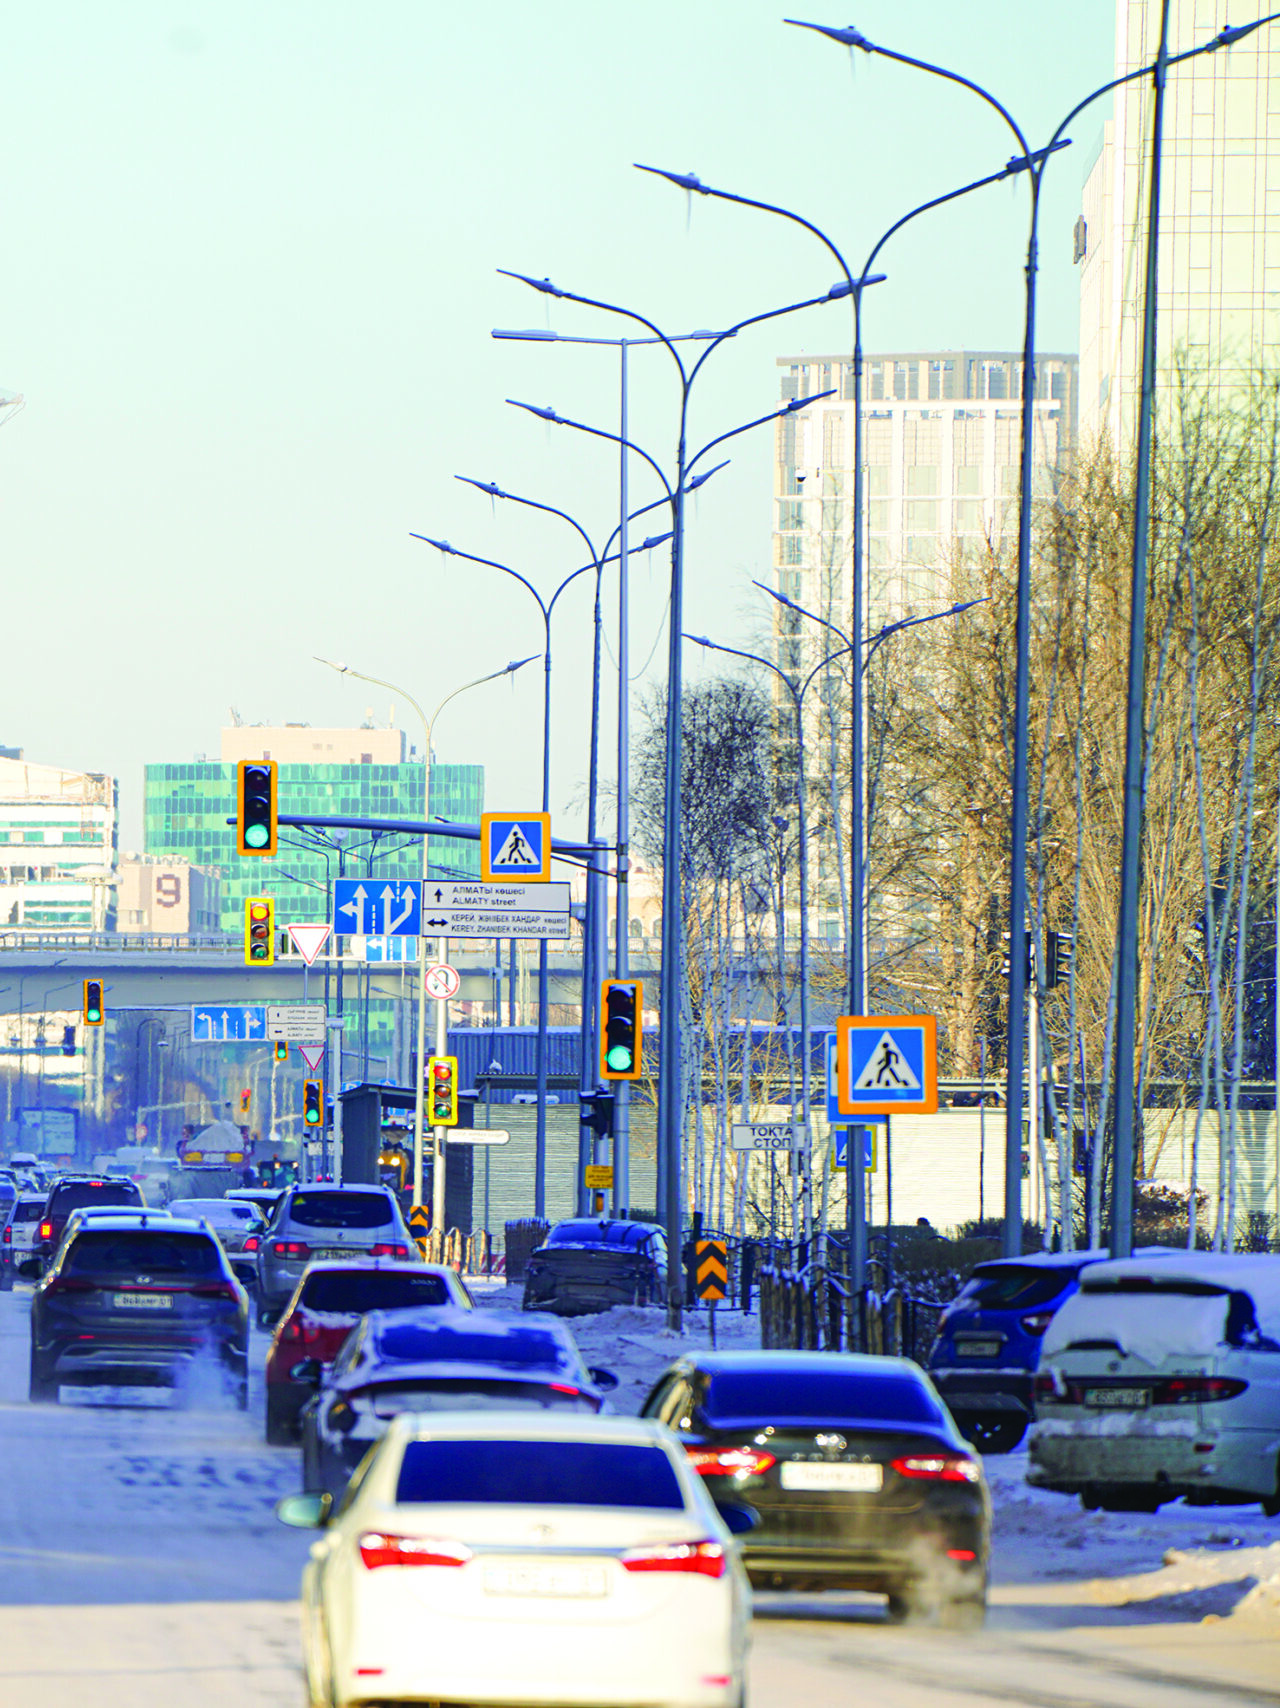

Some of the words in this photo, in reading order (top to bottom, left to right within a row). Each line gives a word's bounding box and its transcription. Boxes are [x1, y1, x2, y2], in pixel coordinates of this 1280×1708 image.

[156, 873, 181, 908] 9
[452, 886, 493, 895] АЛМАТЫ
[452, 897, 489, 905] ALMATY
[491, 898, 517, 906] street
[754, 1138, 791, 1148] СТОП
